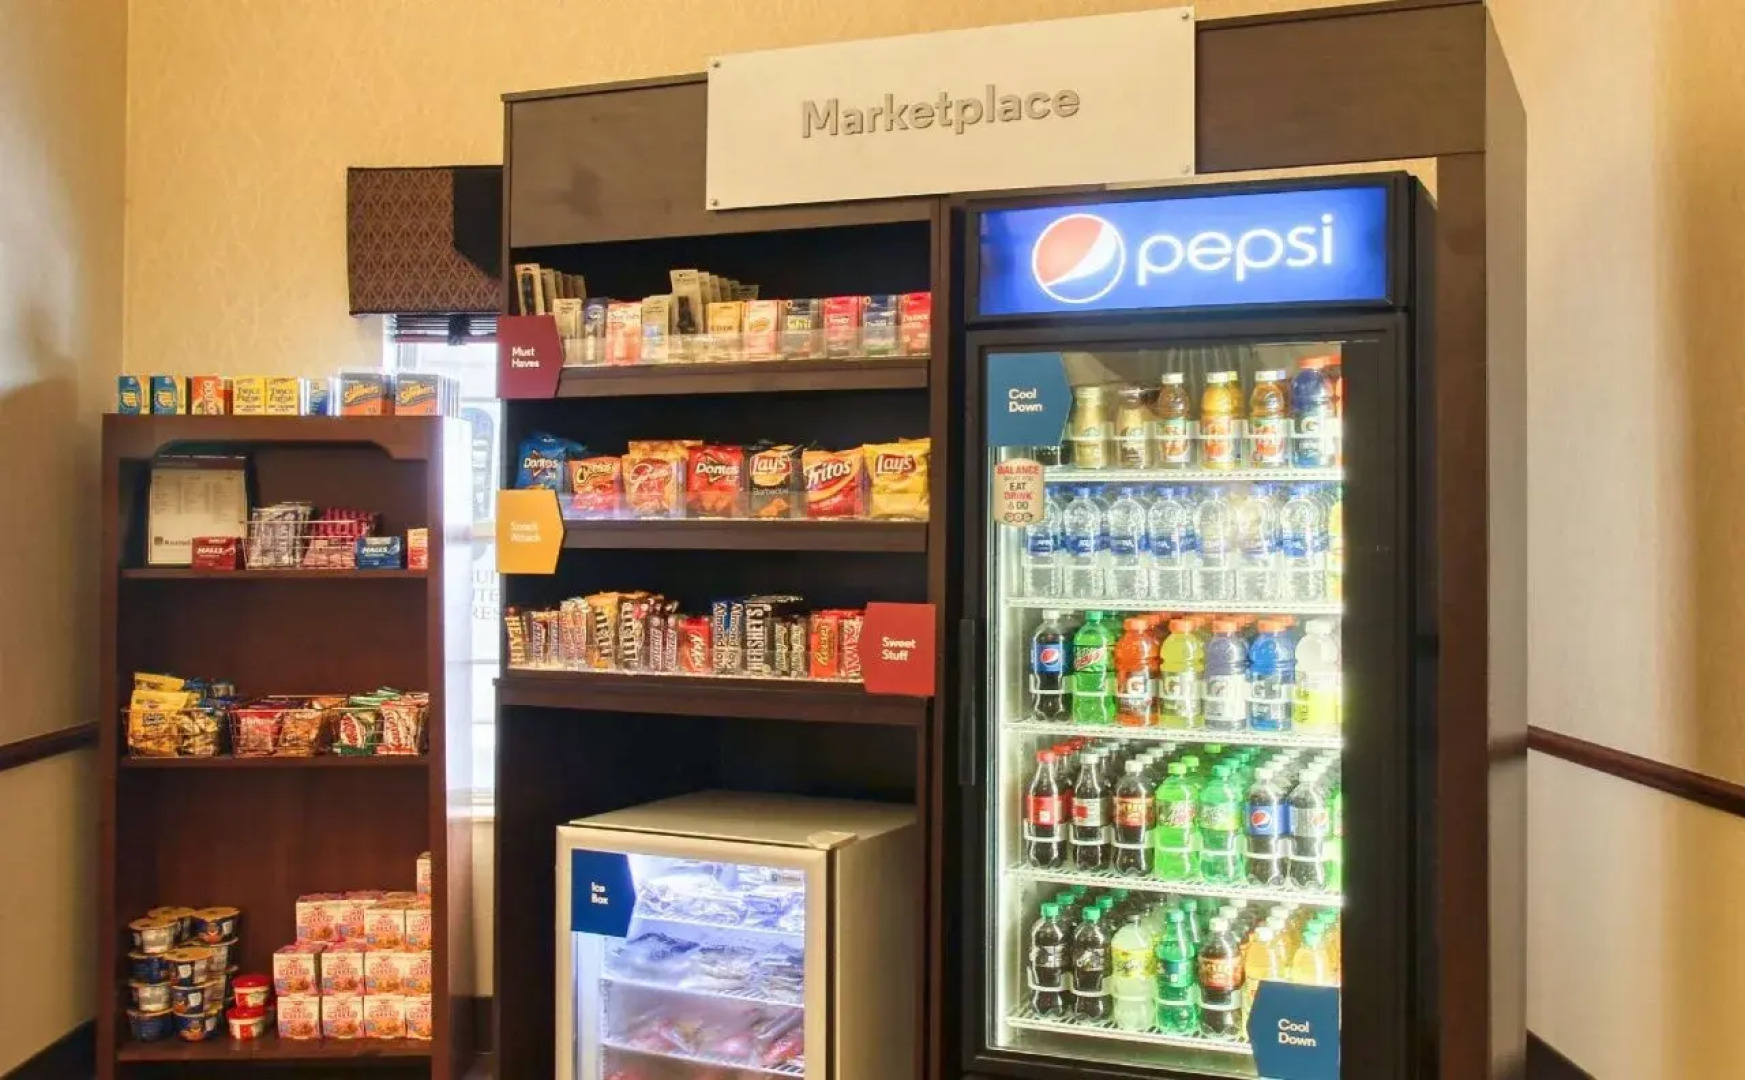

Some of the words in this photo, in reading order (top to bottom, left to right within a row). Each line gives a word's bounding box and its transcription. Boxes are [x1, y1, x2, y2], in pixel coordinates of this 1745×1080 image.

[801, 84, 1082, 138] Marketplace
[1136, 213, 1334, 286] pepsi
[511, 346, 535, 357] Must
[511, 358, 540, 368] Haves
[1009, 388, 1037, 400] Cool
[1009, 401, 1043, 412] Down
[523, 457, 559, 469] Doritos
[696, 462, 740, 476] Doritos
[806, 460, 852, 489] Fritos
[997, 465, 1040, 475] BALANCE
[1010, 482, 1026, 490] EAT
[1004, 491, 1032, 500] DRINK
[1017, 502, 1028, 510] DO
[505, 617, 526, 664] HEATH
[747, 608, 764, 670] HERSHEY'S
[881, 637, 916, 650] Sweet
[881, 649, 909, 661] Stuff
[591, 881, 605, 892] Ice
[591, 893, 609, 904] Box
[1277, 1018, 1310, 1035] Cool
[1278, 1032, 1317, 1047] Down
